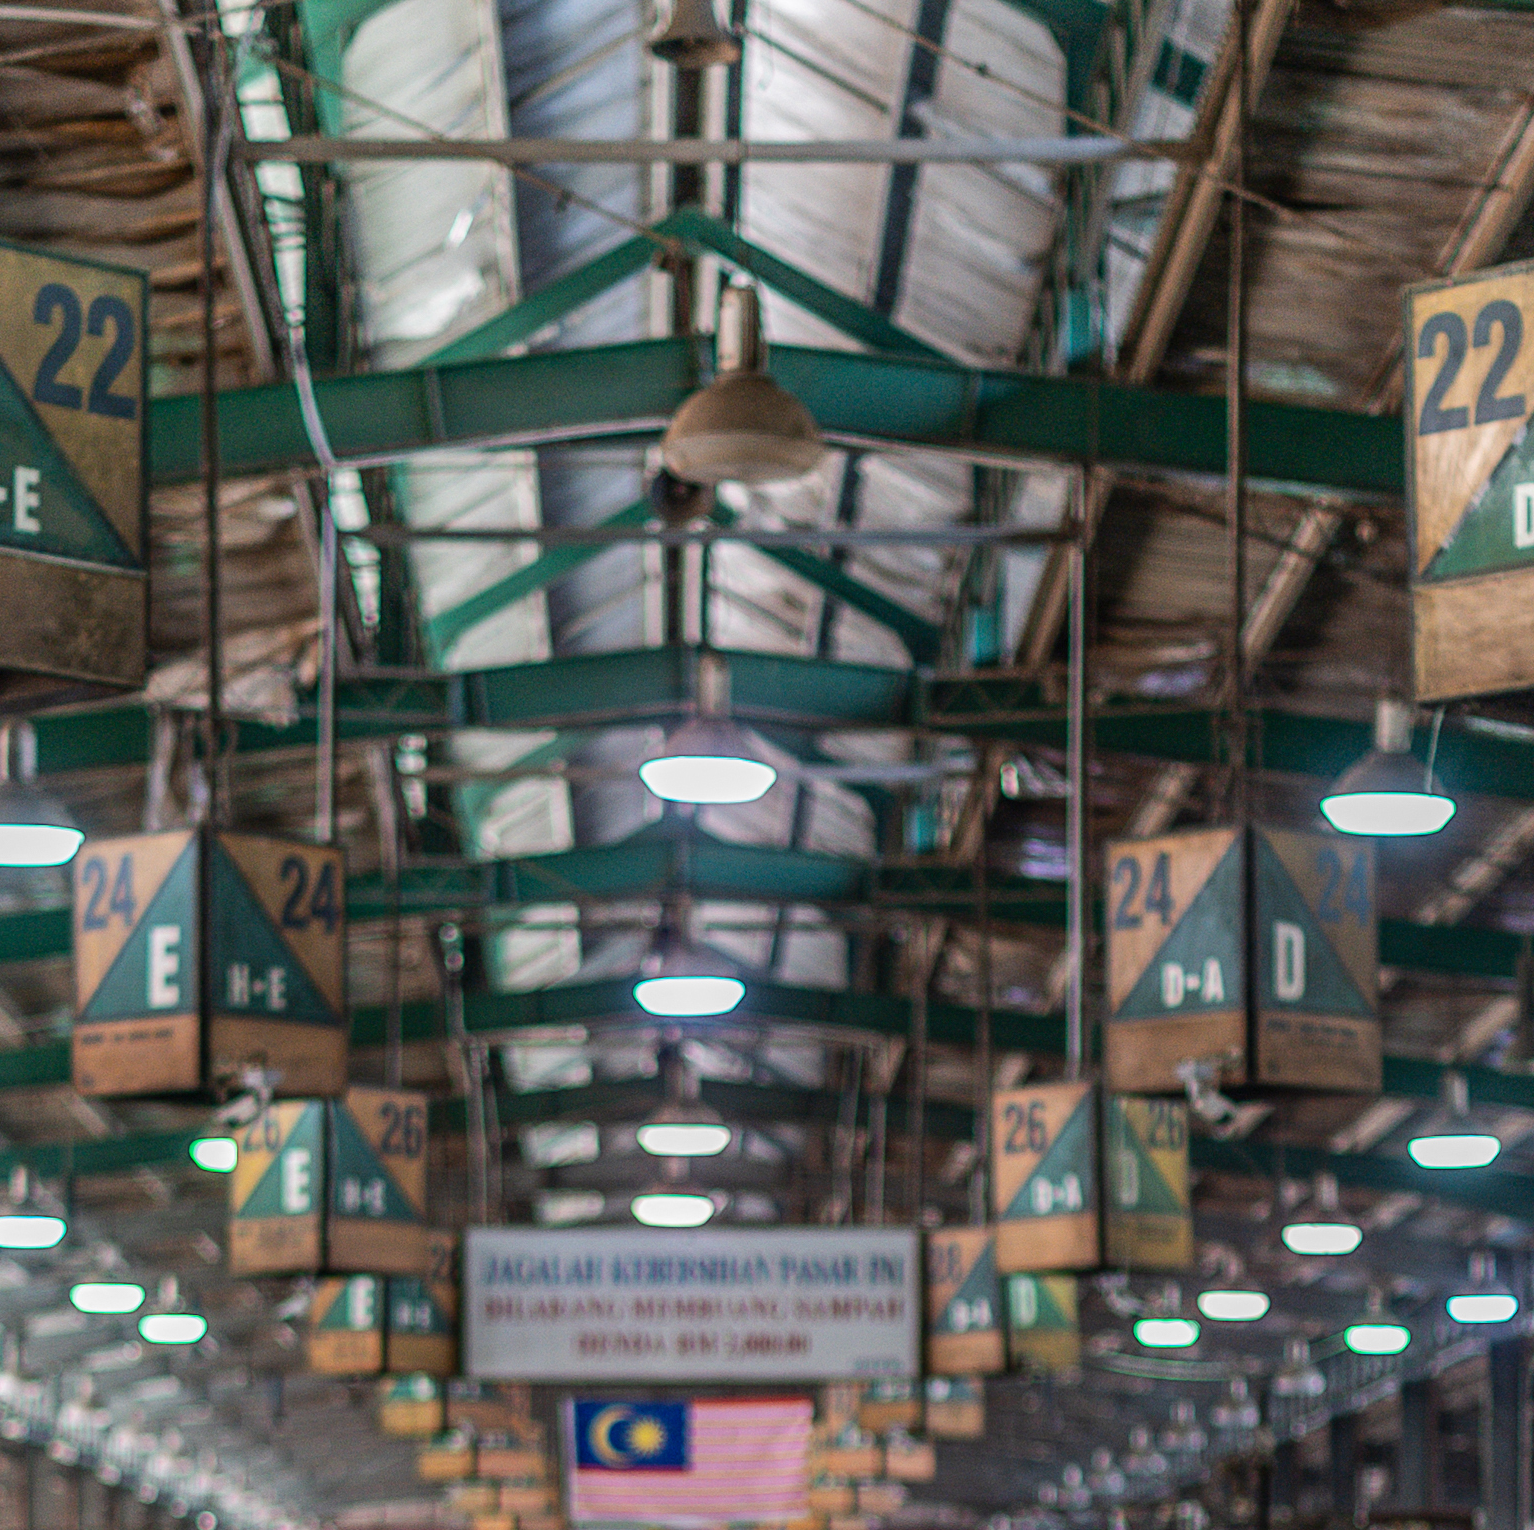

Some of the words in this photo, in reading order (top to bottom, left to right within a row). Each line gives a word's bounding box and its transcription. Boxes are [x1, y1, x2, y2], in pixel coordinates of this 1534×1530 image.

[33, 284, 138, 420] 22
[1417, 300, 1526, 437] 22
[14, 466, 42, 534] E
[81, 852, 137, 931] 24
[280, 856, 340, 934] 24
[1113, 852, 1176, 930] 24
[1318, 849, 1370, 928] 24
[147, 924, 181, 1009] E
[1273, 919, 1306, 1002] D
[379, 1100, 422, 1159] 26
[1003, 1101, 1048, 1155] 26
[281, 1148, 311, 1215] E
[347, 1274, 376, 1330] E
